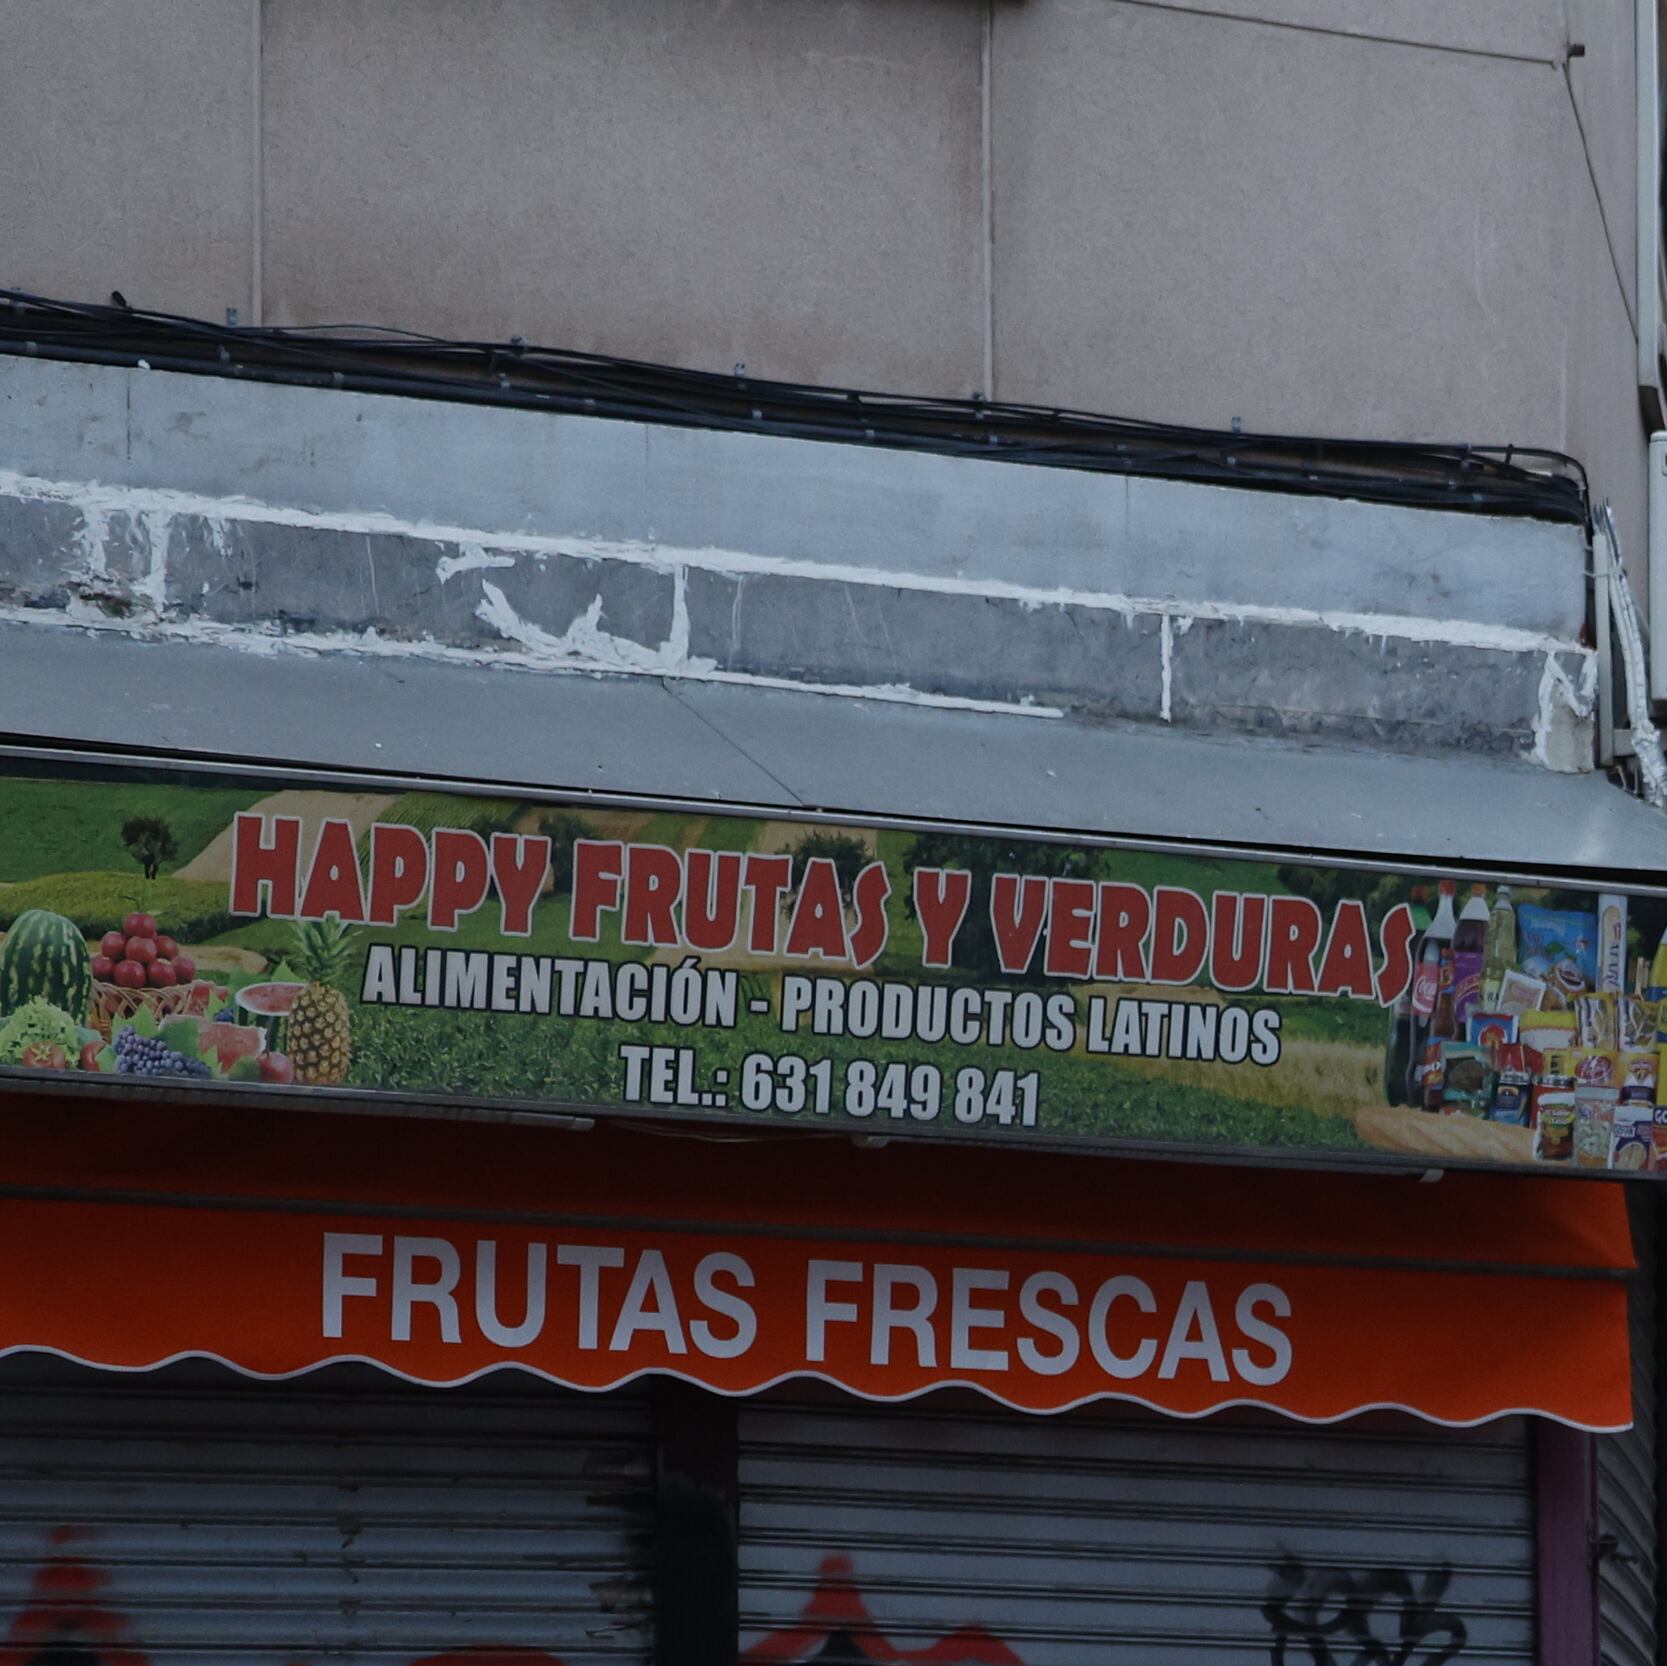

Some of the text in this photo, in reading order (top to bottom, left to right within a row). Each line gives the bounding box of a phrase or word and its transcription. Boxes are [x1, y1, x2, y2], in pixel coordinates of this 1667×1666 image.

[230, 811, 1416, 1007] HAPPY FRUTAS Y VERDURAS
[361, 944, 738, 1028] ALIMENTACIÓN
[781, 974, 1076, 1055] PRODUCTOS
[1087, 994, 1282, 1067] LATINOS
[620, 1045, 1041, 1128] TEL.: 631 849 841
[323, 1232, 1293, 1387] FRUTAS FRESCAS
